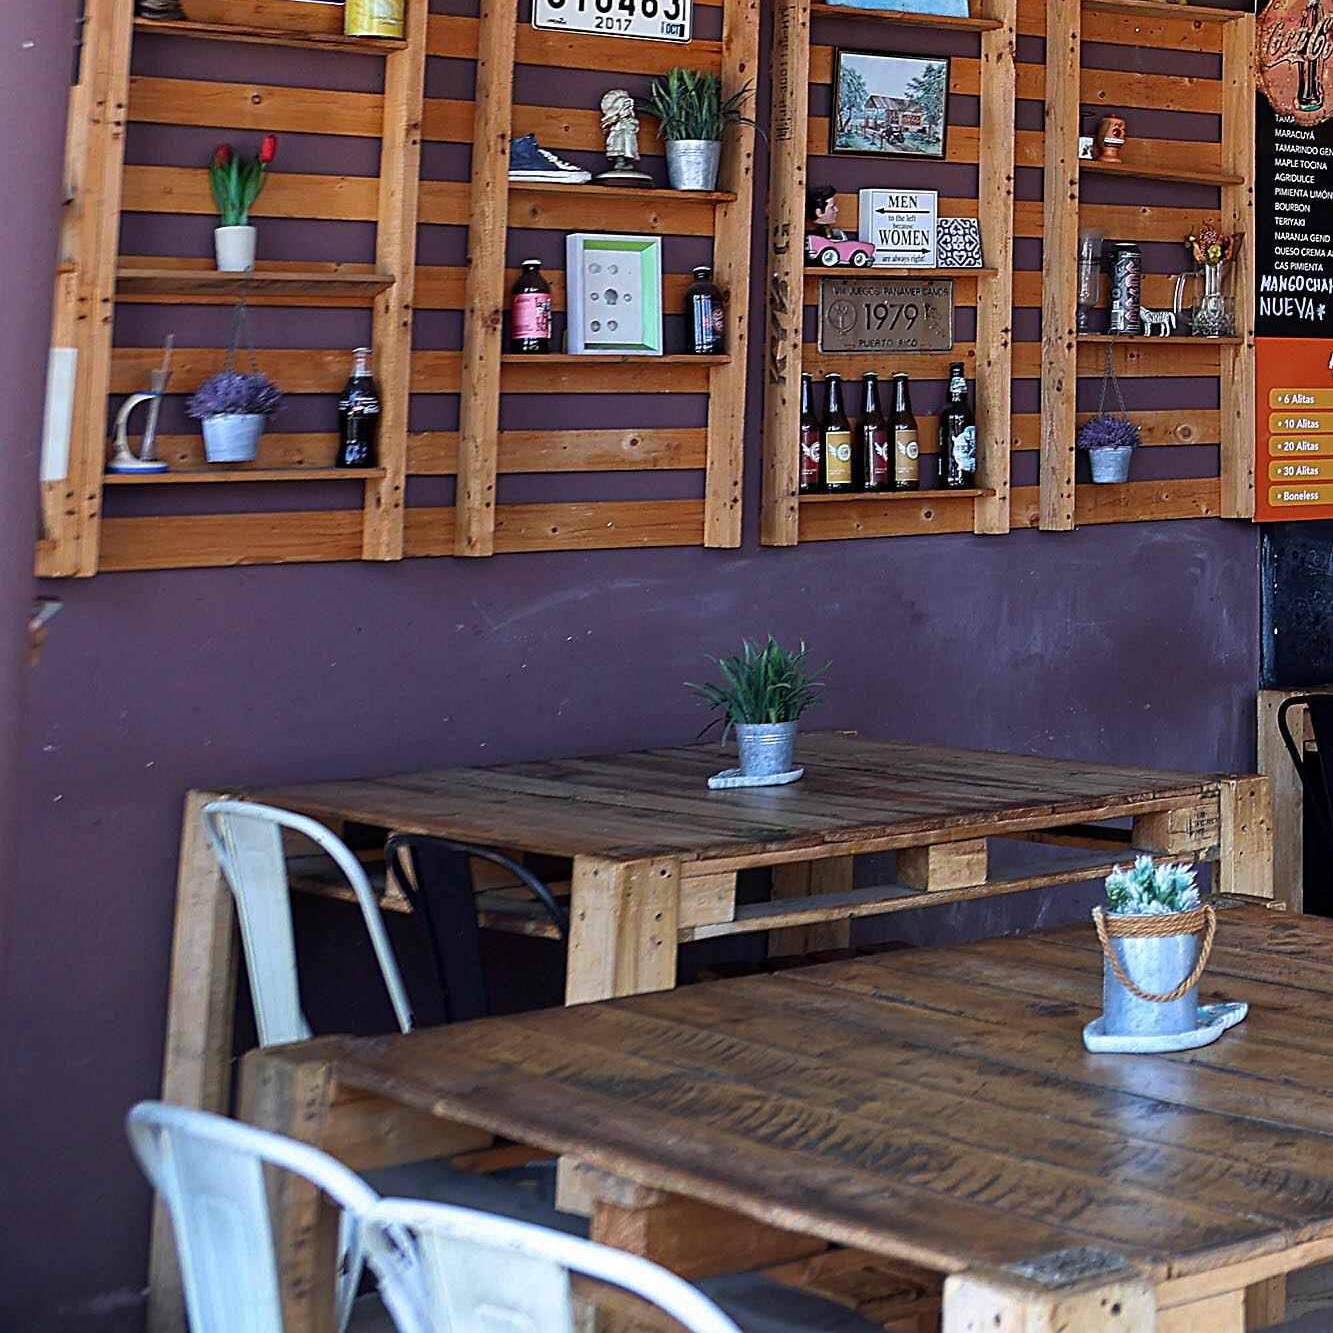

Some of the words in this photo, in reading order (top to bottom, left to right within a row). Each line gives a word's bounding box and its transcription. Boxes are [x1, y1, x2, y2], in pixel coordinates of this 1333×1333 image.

[595, 16, 632, 31] 2017
[1275, 144, 1318, 155] TAMARINDO
[1275, 159, 1299, 168] MAPLE
[1275, 173, 1315, 183] AGRIDULCE
[1275, 188, 1308, 198] PIMIENTA
[889, 196, 918, 208] MEN
[1275, 203, 1310, 212] BOURBON
[1275, 218, 1305, 226] TERIYAKI
[879, 230, 930, 245] WOMEN
[1275, 232, 1308, 242] NARANJA
[1275, 247, 1300, 256] QUESO
[1301, 249, 1326, 257] CREMA
[892, 255, 910, 263] always
[1275, 262, 1288, 270] CAS
[1290, 263, 1323, 271] PIMIENTA
[1260, 276, 1304, 292] MANGO
[850, 287, 880, 295] JUEGOS
[884, 288, 948, 296] PANAMERICANOS
[864, 304, 918, 330] 1979
[859, 339, 892, 347] PUERTO
[1291, 395, 1315, 403] Alitas
[1284, 420, 1294, 428] 10
[1296, 420, 1319, 429] Alitas
[1284, 442, 1295, 451] 20
[1297, 442, 1319, 451] Alitas
[1284, 467, 1295, 475] 30
[1297, 467, 1319, 475] Alitas
[1284, 491, 1319, 500] Boneless
